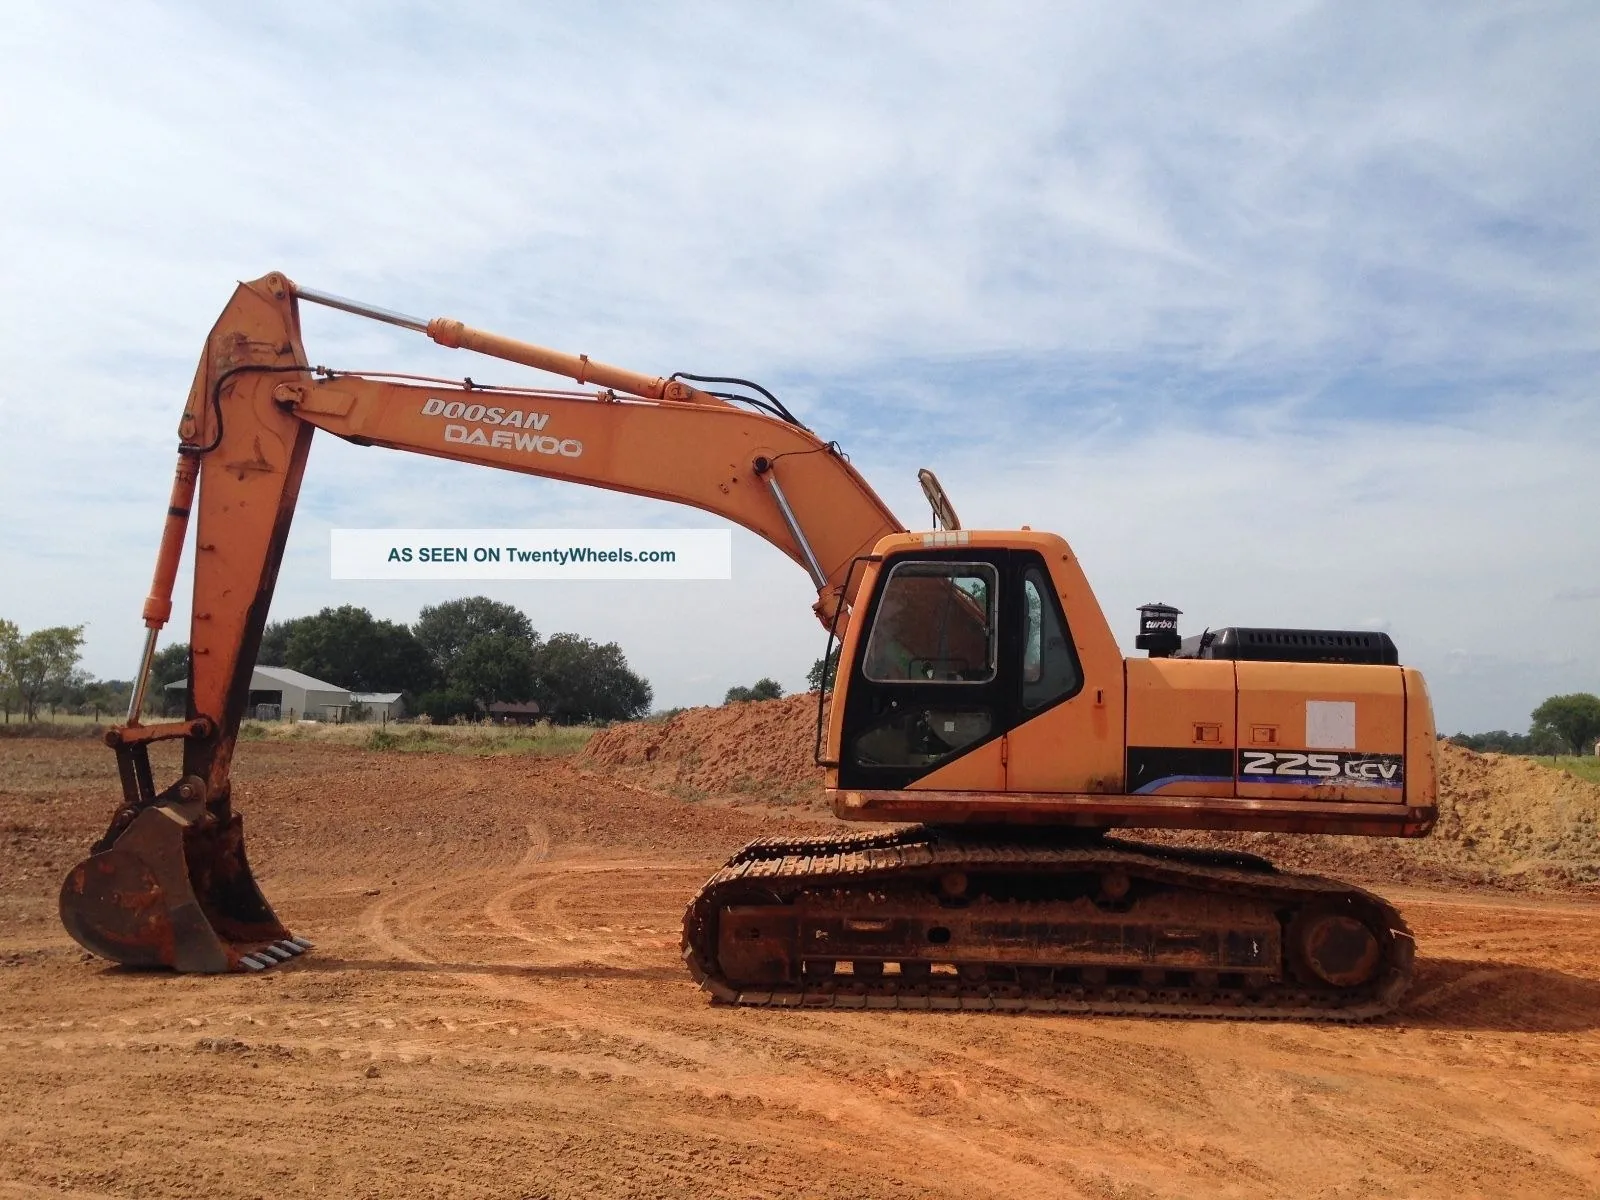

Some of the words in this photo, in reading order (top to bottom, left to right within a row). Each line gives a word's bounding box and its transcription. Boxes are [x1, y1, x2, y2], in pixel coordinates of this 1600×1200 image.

[421, 398, 550, 431] DOOSAN
[444, 424, 583, 458] DAEWOO
[1145, 620, 1172, 629] turbo
[1243, 752, 1340, 777] 225
